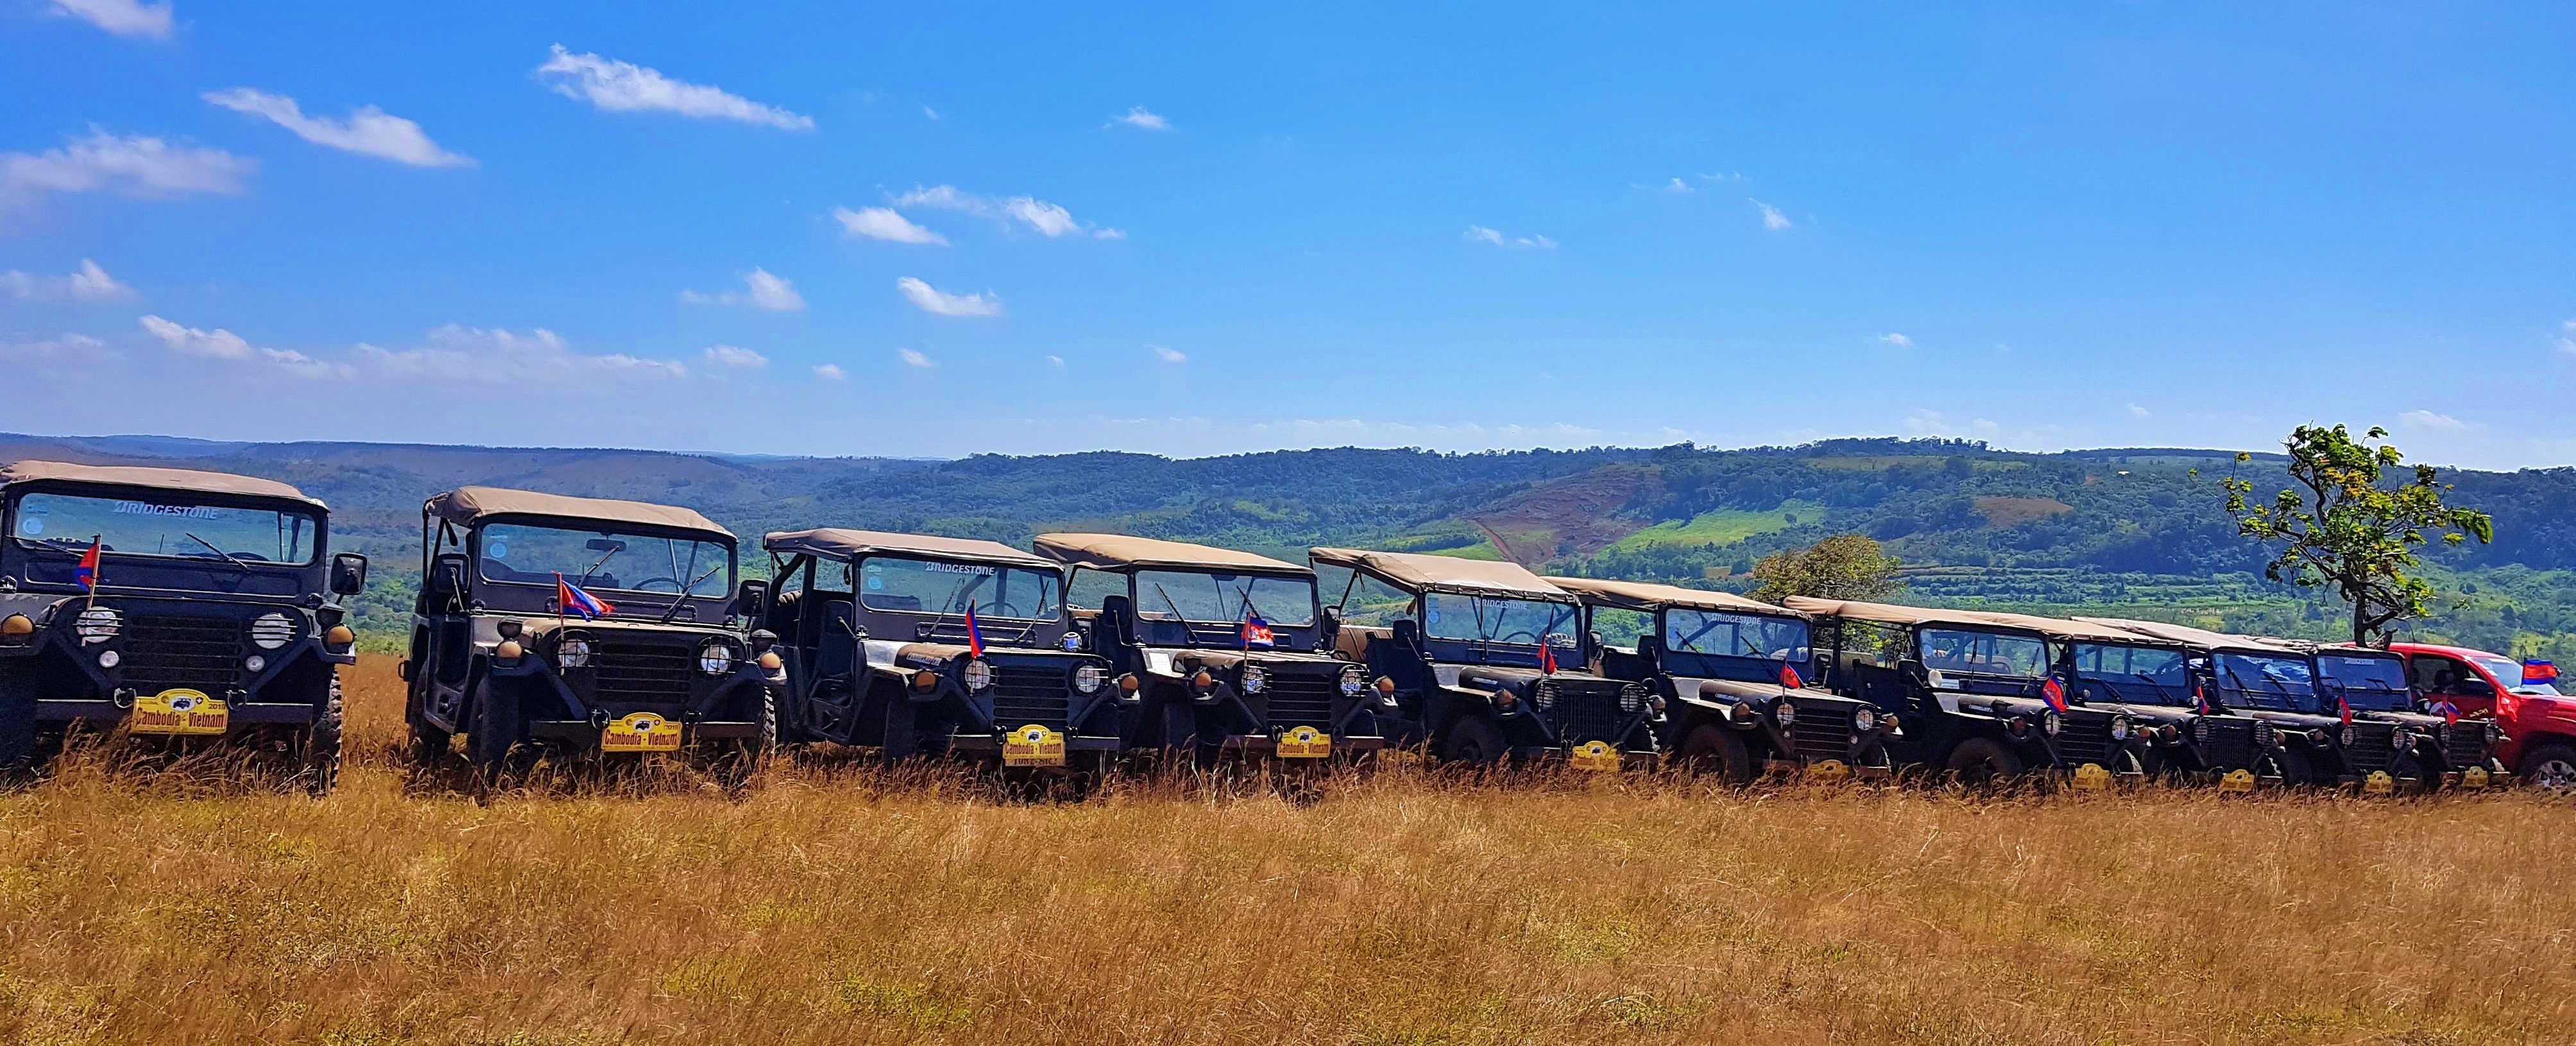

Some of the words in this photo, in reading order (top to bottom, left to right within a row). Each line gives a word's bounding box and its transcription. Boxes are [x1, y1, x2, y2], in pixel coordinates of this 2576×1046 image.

[112, 501, 219, 519] BRIDGESTONE
[925, 562, 995, 576] BRIDGESTONE
[1712, 613, 1762, 626] BRIDGESTONE
[136, 707, 181, 726] Cambodia
[188, 712, 225, 728] Vietnam
[605, 729, 642, 745] Cambodia
[648, 732, 678, 746] Vietnam
[1005, 741, 1034, 755] Cambodia
[1038, 742, 1061, 755] Vietnam
